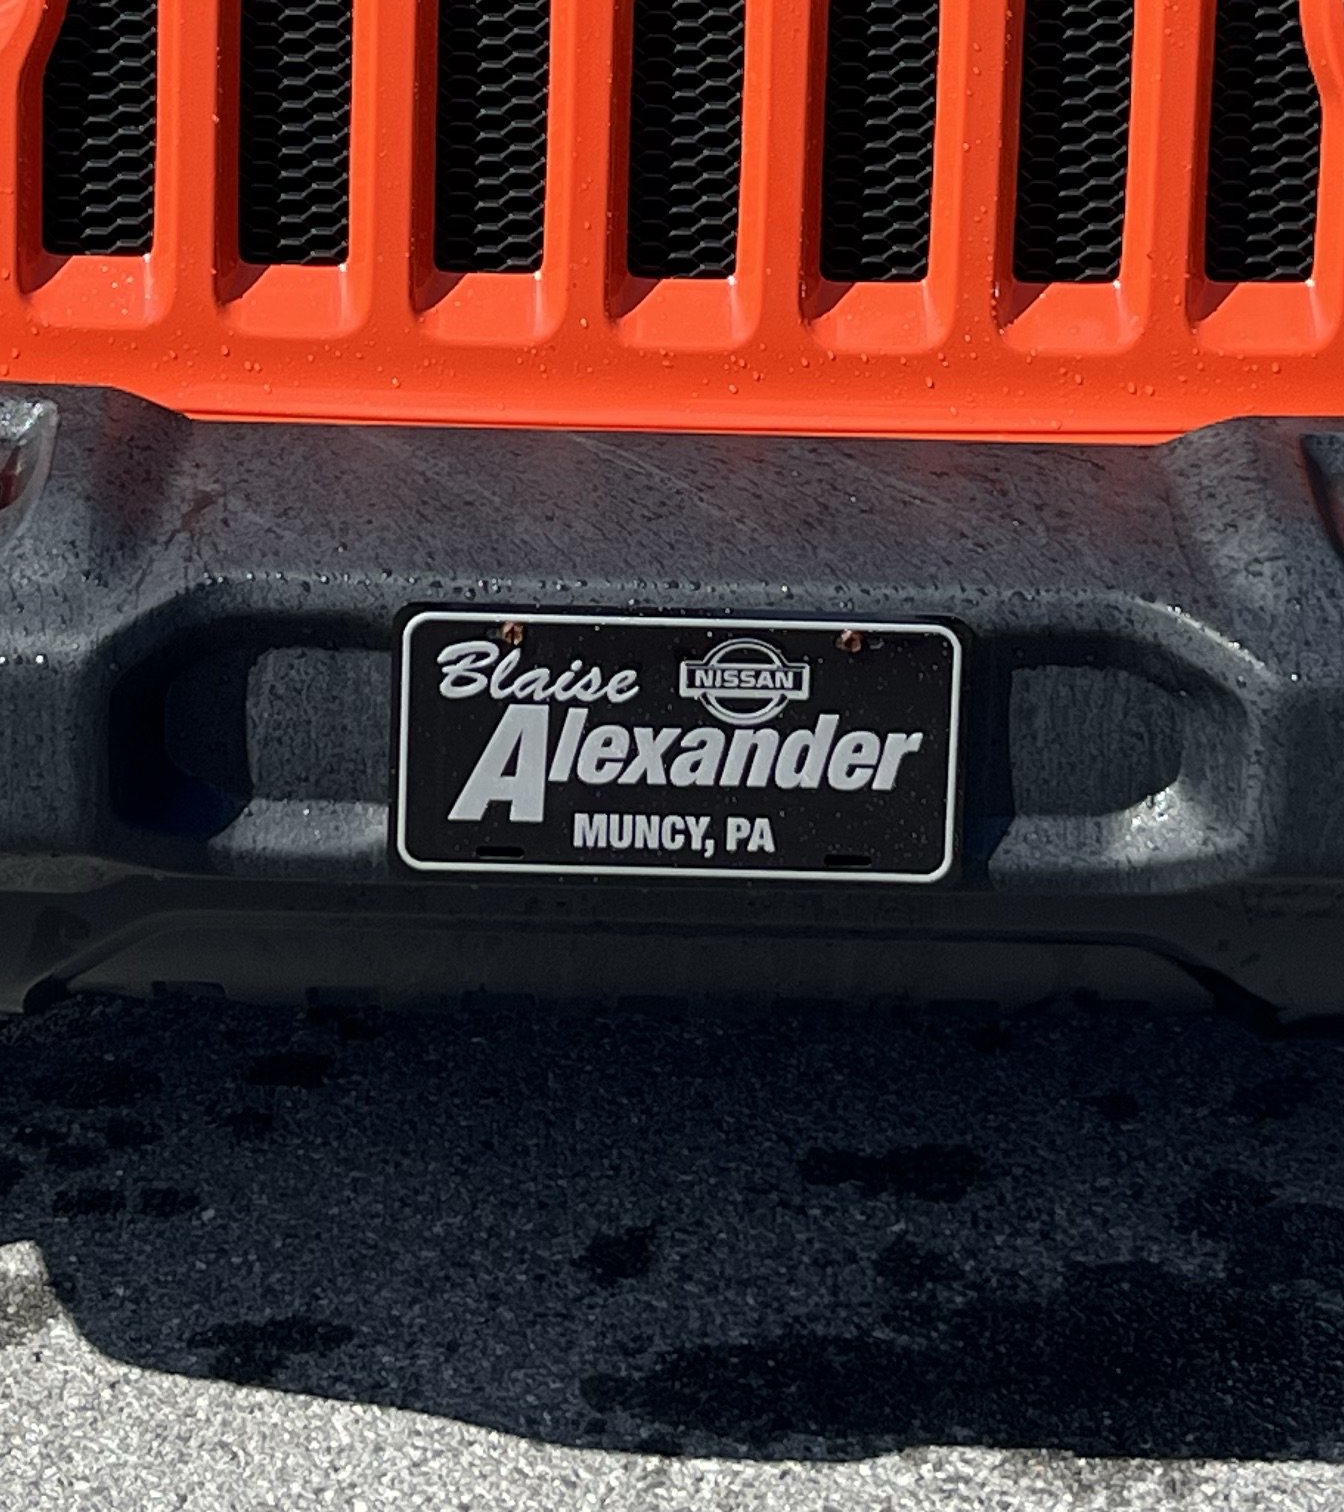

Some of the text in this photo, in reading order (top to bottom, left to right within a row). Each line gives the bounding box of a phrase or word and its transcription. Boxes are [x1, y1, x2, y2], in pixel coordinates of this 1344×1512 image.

[437, 641, 640, 703] Blaise
[694, 667, 795, 690] NISSAN
[448, 703, 923, 823] Alexander
[573, 813, 775, 857] MUNCY, PA
